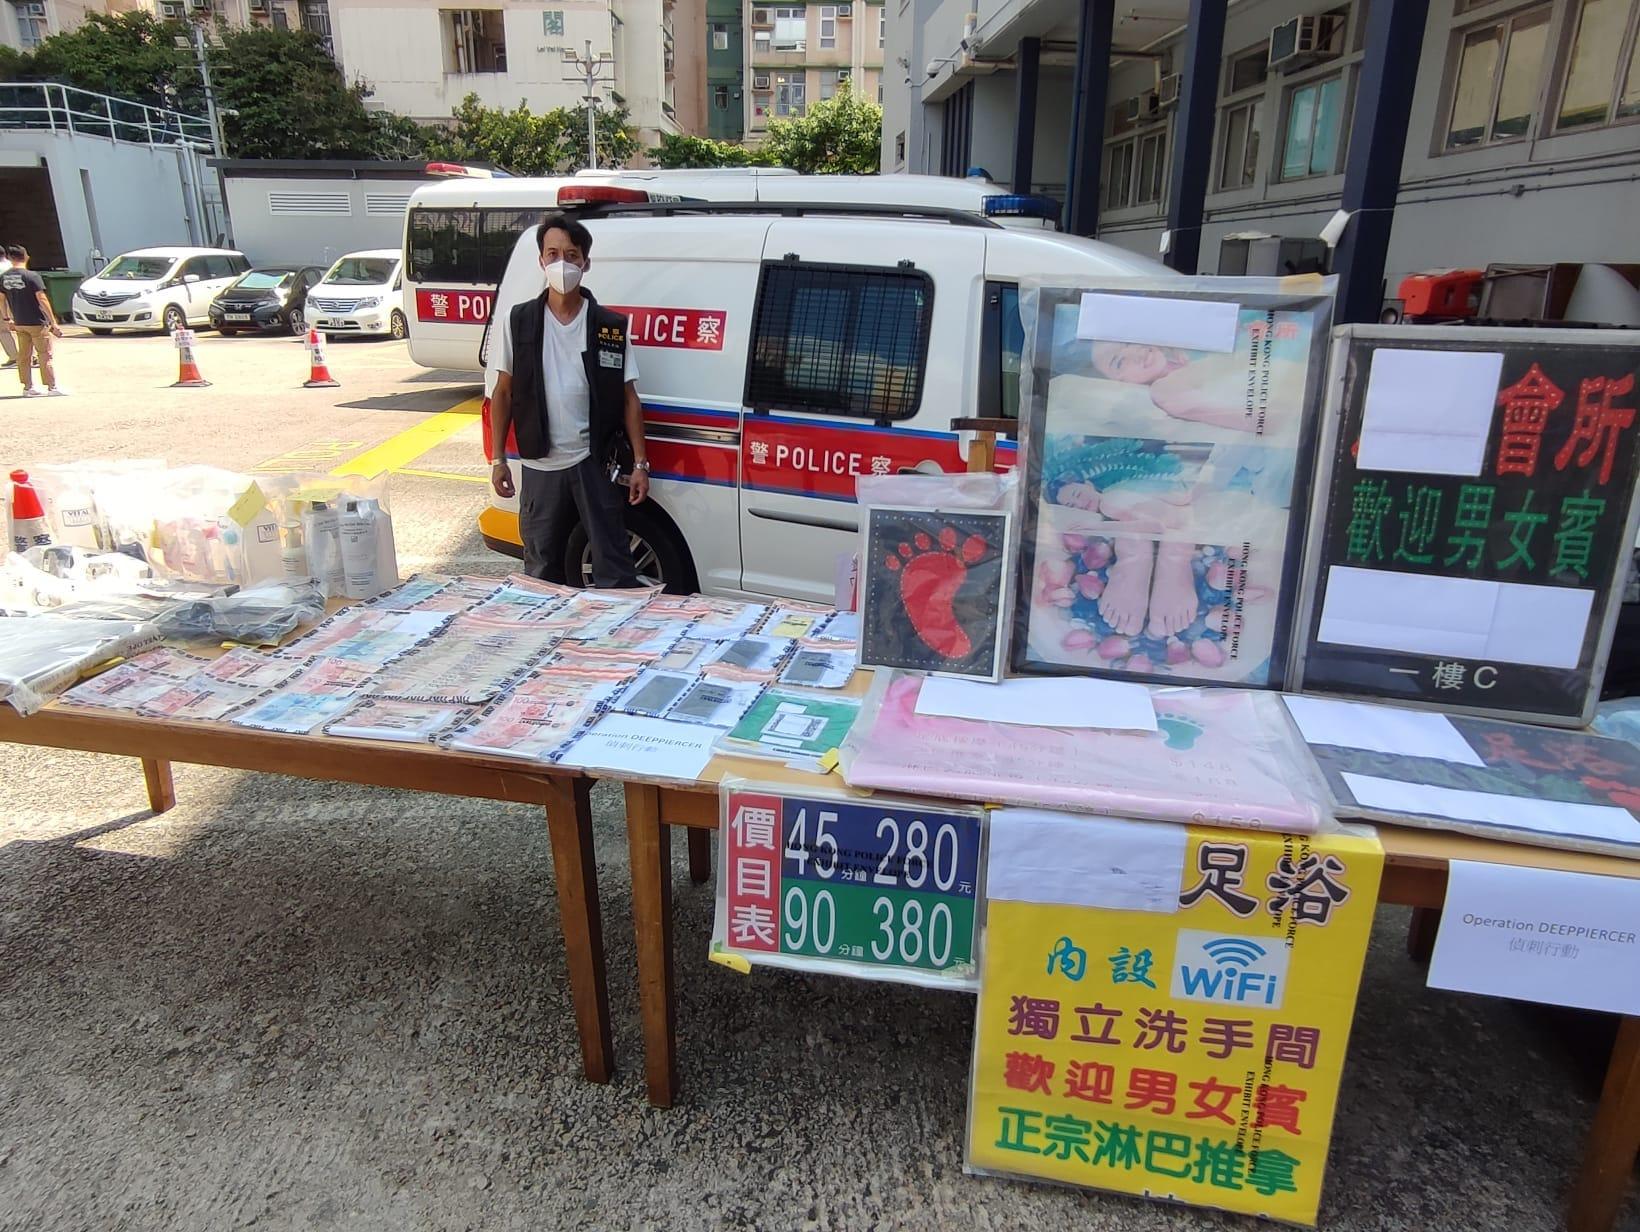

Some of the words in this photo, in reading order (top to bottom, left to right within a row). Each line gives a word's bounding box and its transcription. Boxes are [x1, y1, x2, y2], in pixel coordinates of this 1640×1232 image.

[430, 293, 449, 317] 警
[598, 333, 624, 342] POLICE
[697, 315, 721, 344] 察
[750, 441, 769, 464] 警
[776, 444, 862, 476] POLICE
[1346, 478, 1607, 579] 歡迎男女賓
[731, 804, 776, 946] 價目表
[785, 808, 839, 879] 45
[873, 817, 959, 892] 280
[958, 880, 973, 894] 元
[1179, 841, 1351, 927] 足浴
[785, 886, 836, 954] 90
[871, 896, 953, 967] 380
[1463, 913, 1534, 931] Operation
[1538, 922, 1637, 945] DEEPPIERCER
[1047, 936, 1158, 990] 內設
[1181, 965, 1277, 1004] WiFi
[1008, 995, 1320, 1070] 獨立洗手間
[1003, 1051, 1307, 1136] 歡迎男女賓
[995, 1106, 1302, 1196] 正宗淋巴推拿
